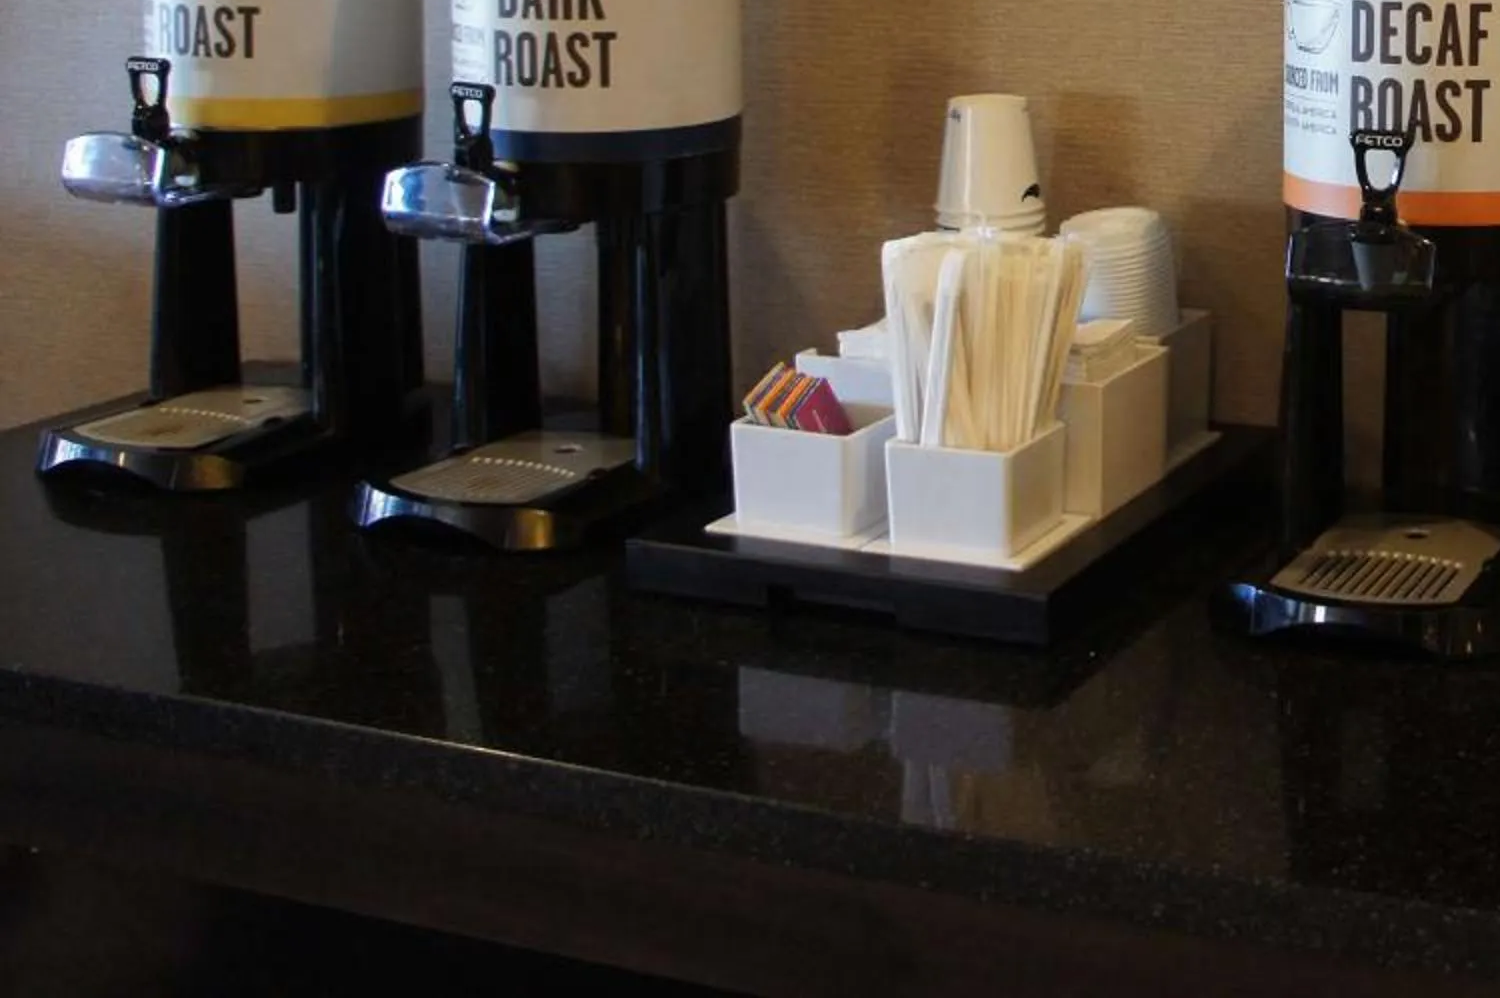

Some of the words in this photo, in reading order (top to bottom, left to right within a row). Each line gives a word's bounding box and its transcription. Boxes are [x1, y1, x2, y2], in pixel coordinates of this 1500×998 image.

[160, 3, 261, 59] ROAST
[494, 29, 617, 88] ROAST
[1351, 0, 1493, 66] DECAF
[1350, 75, 1491, 143] ROAST
[1355, 135, 1403, 147] FETCO
